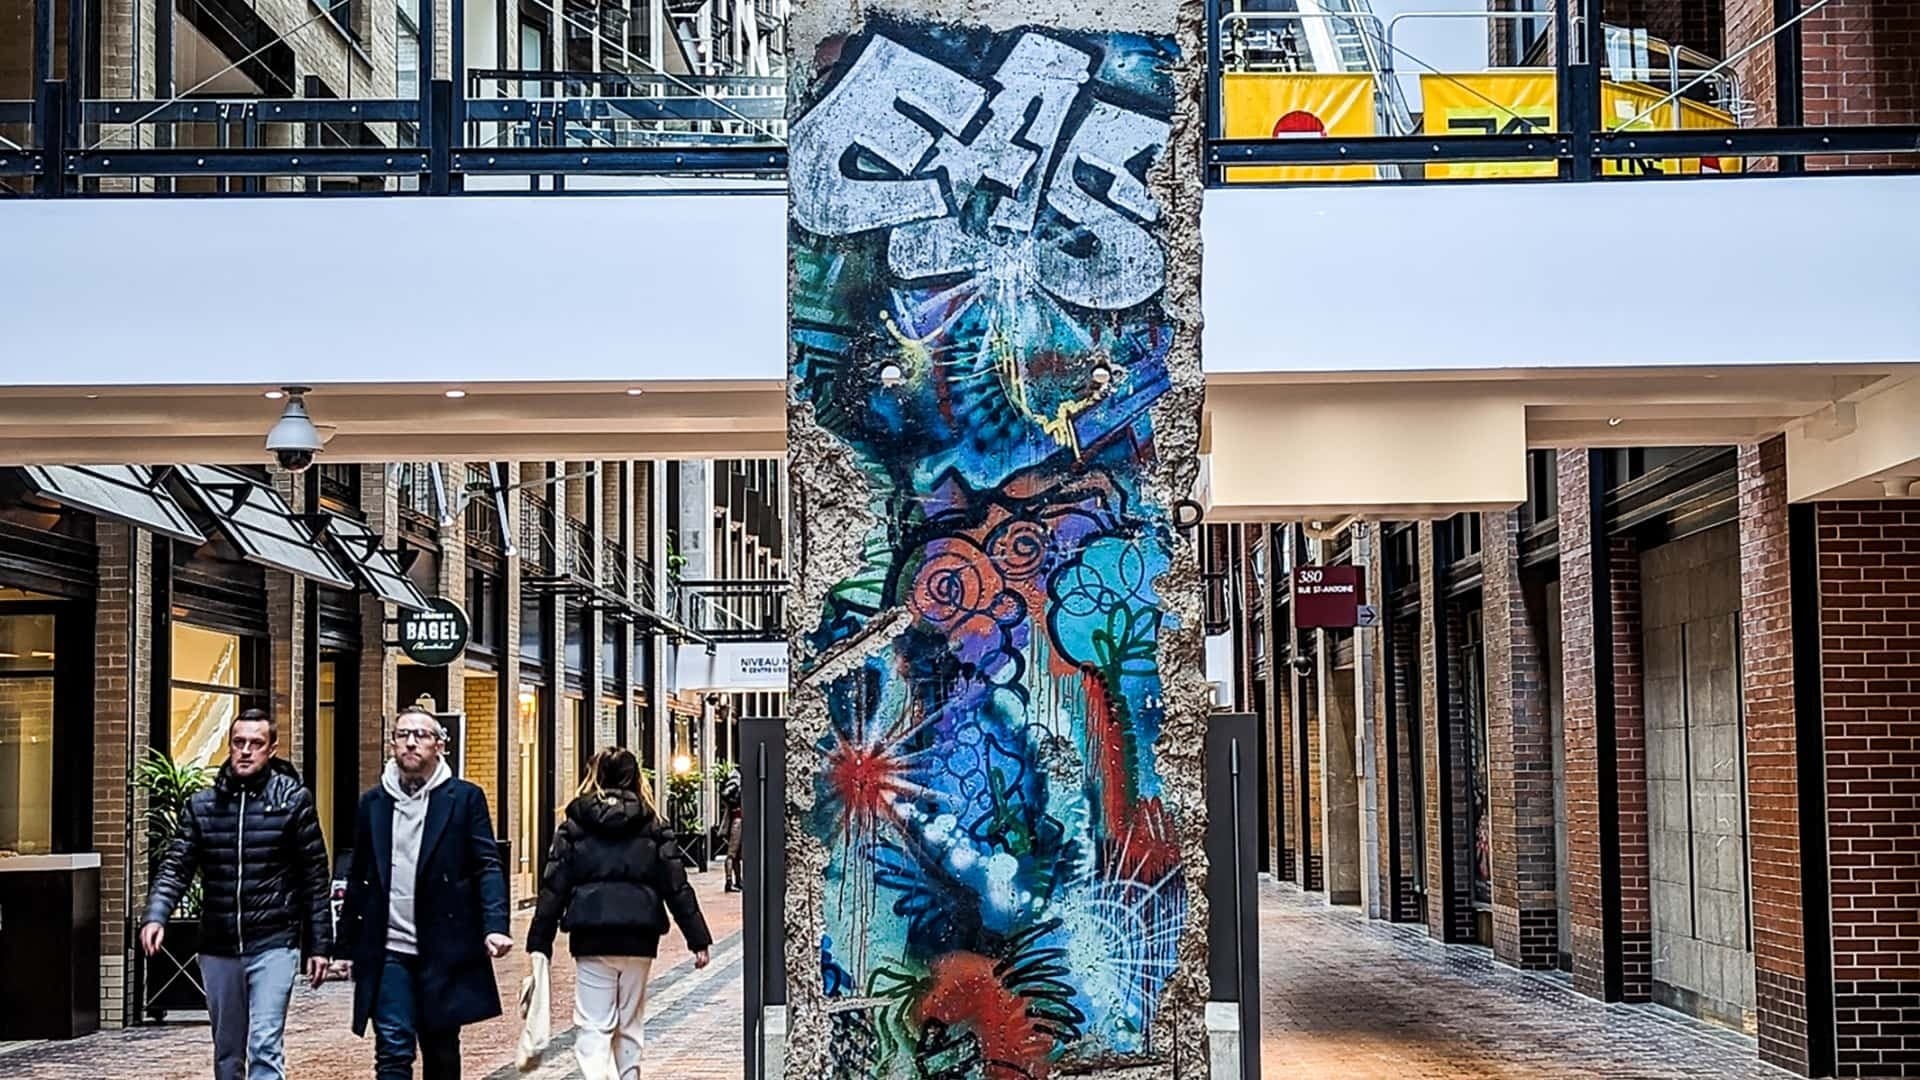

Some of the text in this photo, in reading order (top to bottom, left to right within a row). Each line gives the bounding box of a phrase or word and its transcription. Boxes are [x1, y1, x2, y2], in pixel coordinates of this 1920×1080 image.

[1298, 570, 1323, 583] 380
[406, 621, 460, 640] BAGEL
[741, 658, 779, 666] NIVEAU
